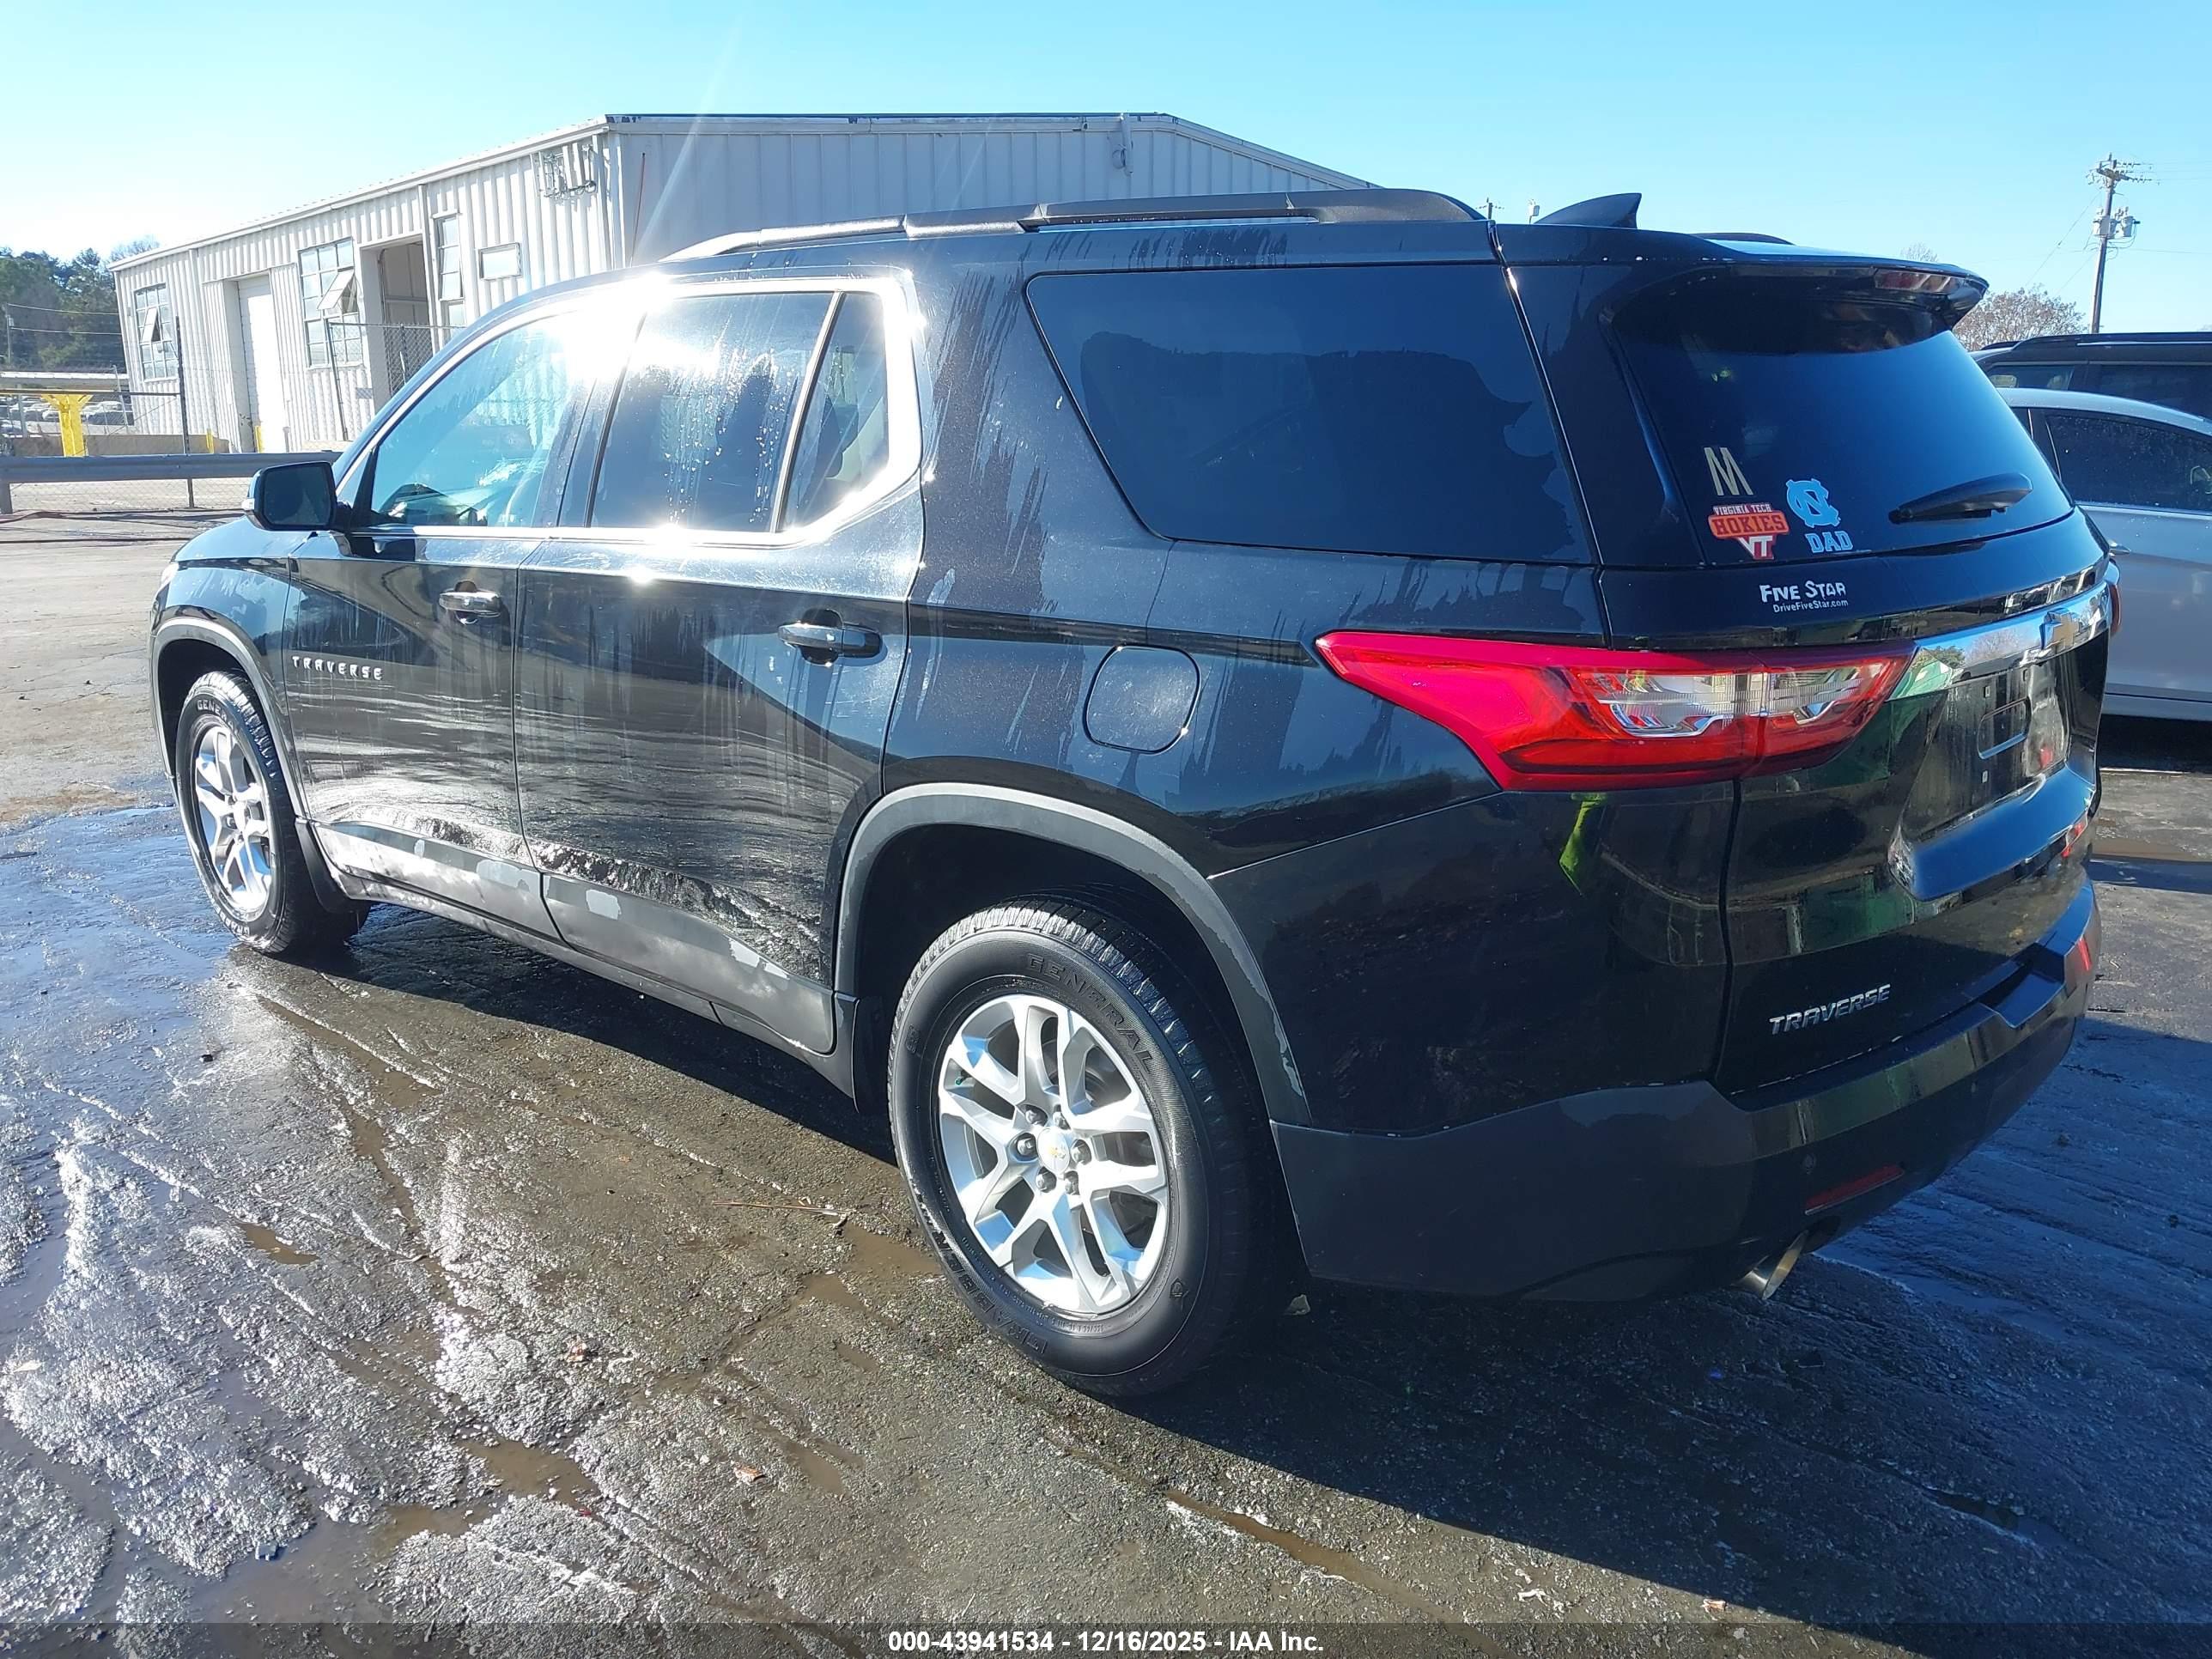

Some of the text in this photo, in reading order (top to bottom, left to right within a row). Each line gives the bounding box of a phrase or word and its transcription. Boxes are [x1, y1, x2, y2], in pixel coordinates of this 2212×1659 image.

[1713, 503, 1773, 516] VIRGINIA TECH
[1711, 515, 1786, 536] HOKIES
[1736, 535, 1774, 558] VT
[1804, 530, 1854, 554] DAD
[1772, 599, 1849, 613] DriveFiveStar.com
[291, 655, 383, 681] TRAVERSE
[1025, 952, 1154, 1074] GENERAL
[1769, 983, 1891, 1036] TRAVERSE
